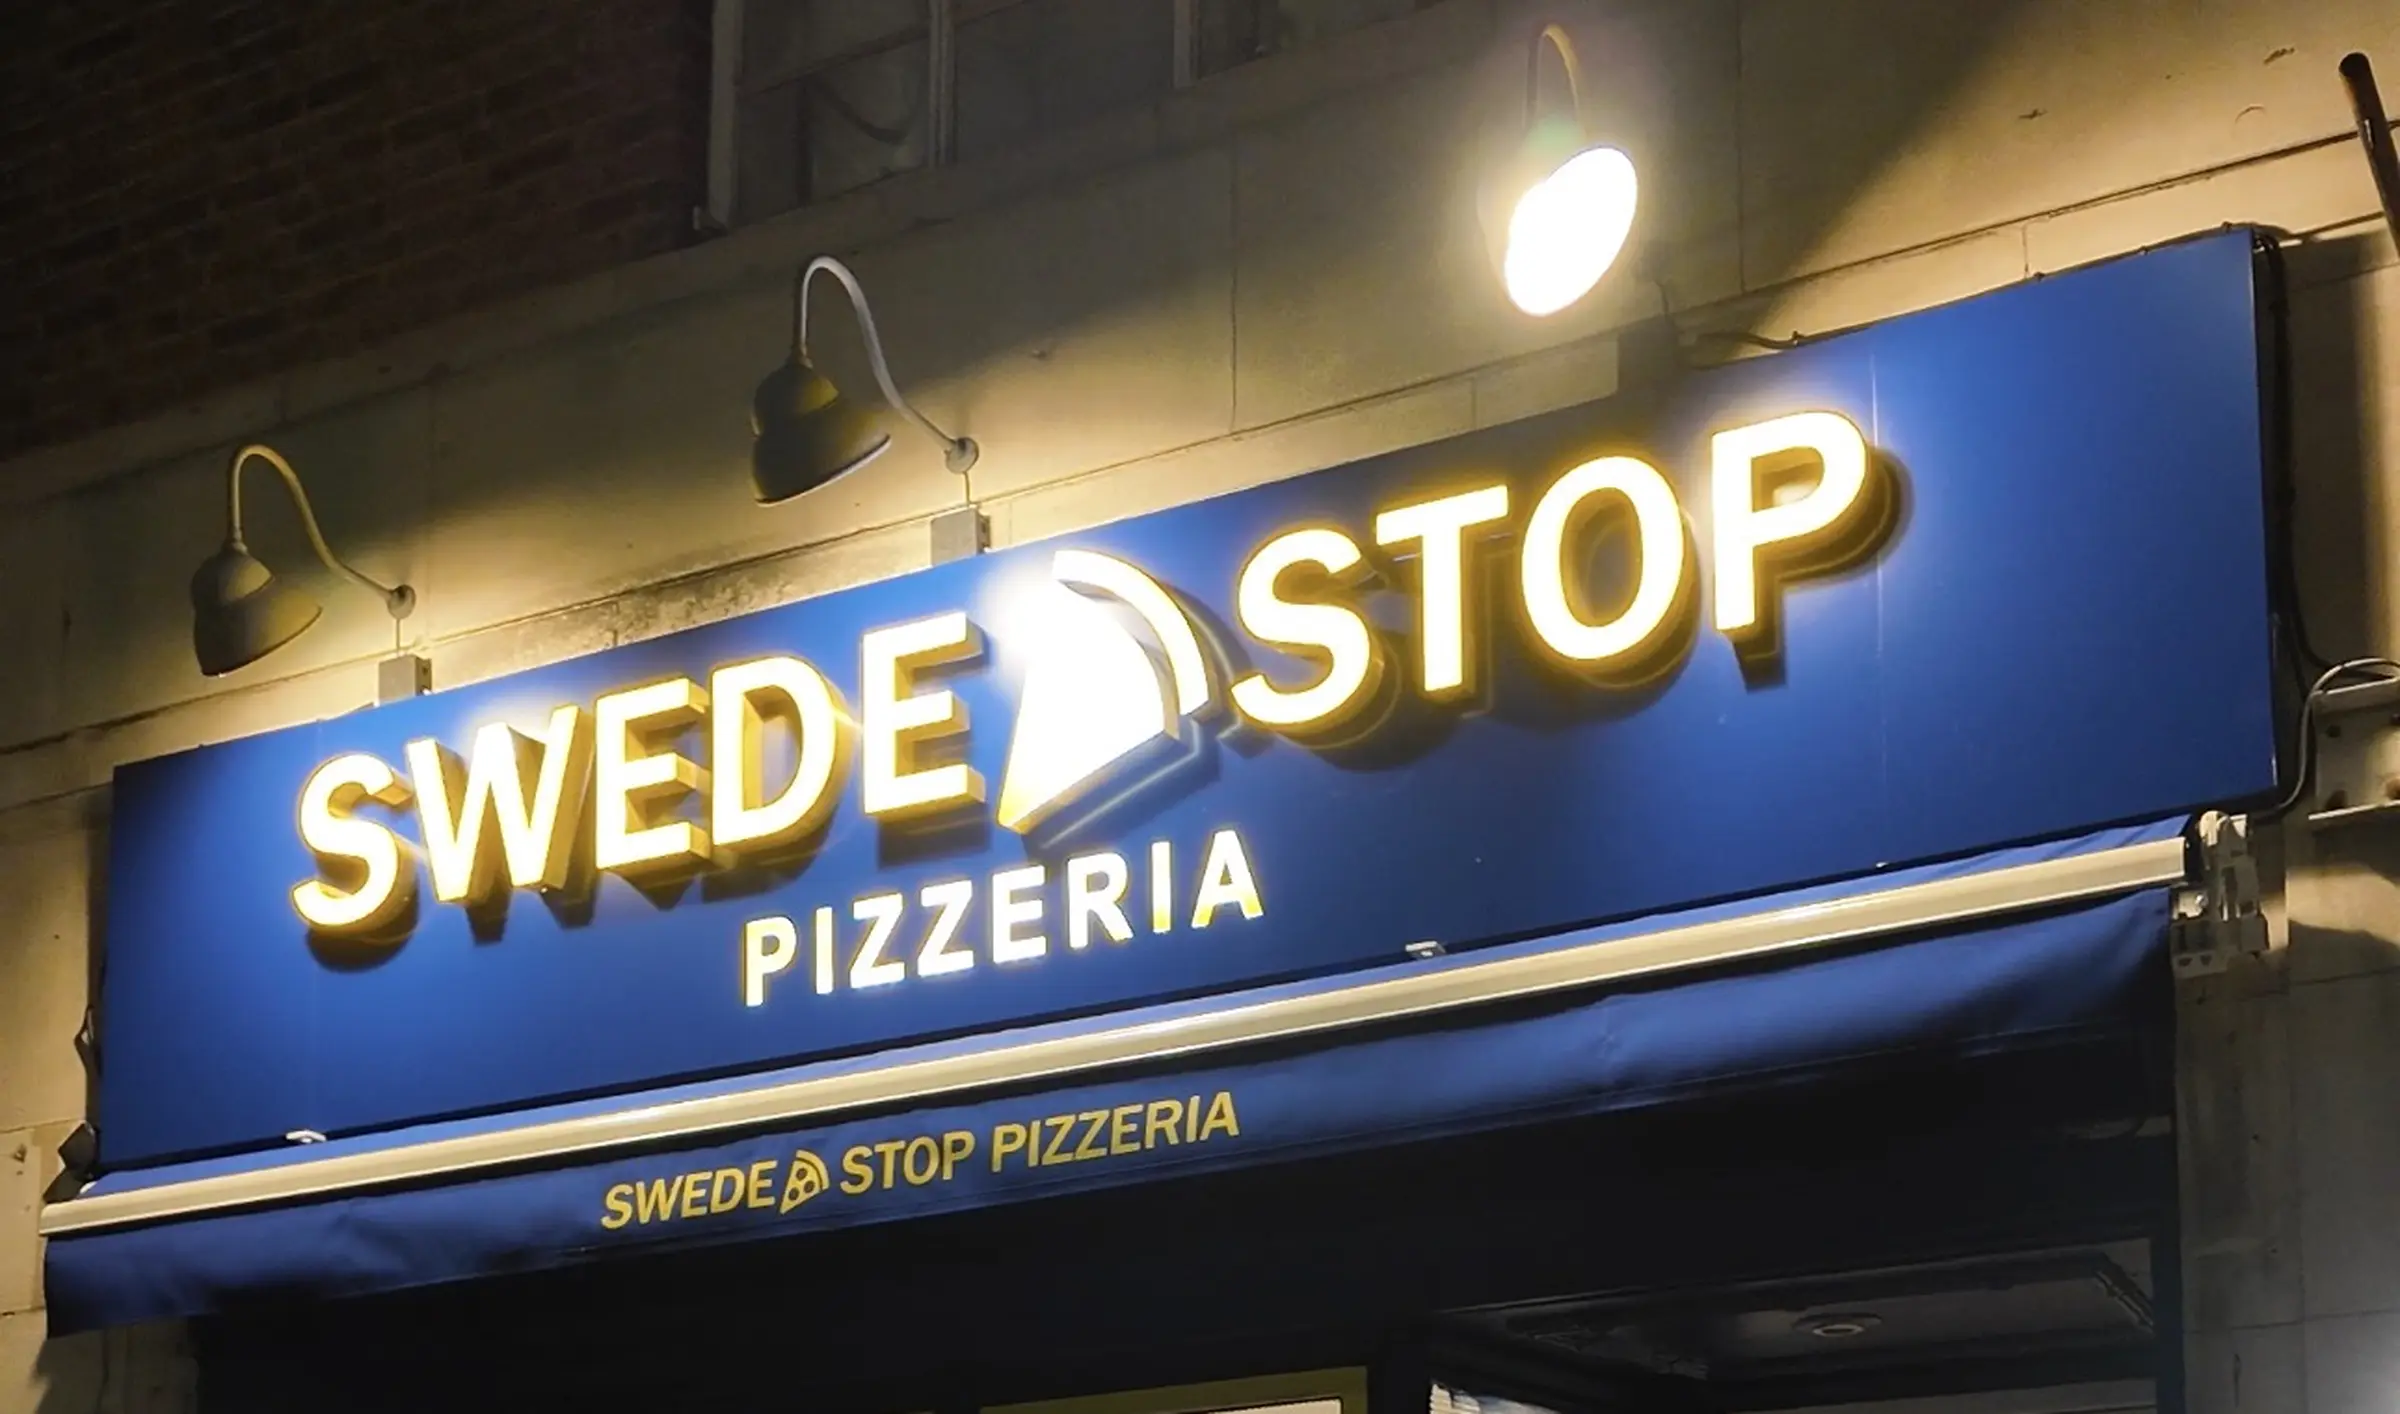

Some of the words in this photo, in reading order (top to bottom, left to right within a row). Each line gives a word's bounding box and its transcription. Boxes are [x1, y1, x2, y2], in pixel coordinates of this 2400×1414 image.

[290, 610, 978, 930] SWEDE
[1229, 410, 1868, 727] STOP
[743, 829, 1265, 1008] PIZZERIA
[600, 1158, 778, 1230] SWEDE
[839, 1129, 976, 1195] STOP
[990, 1090, 1240, 1174] PIZZERIA
